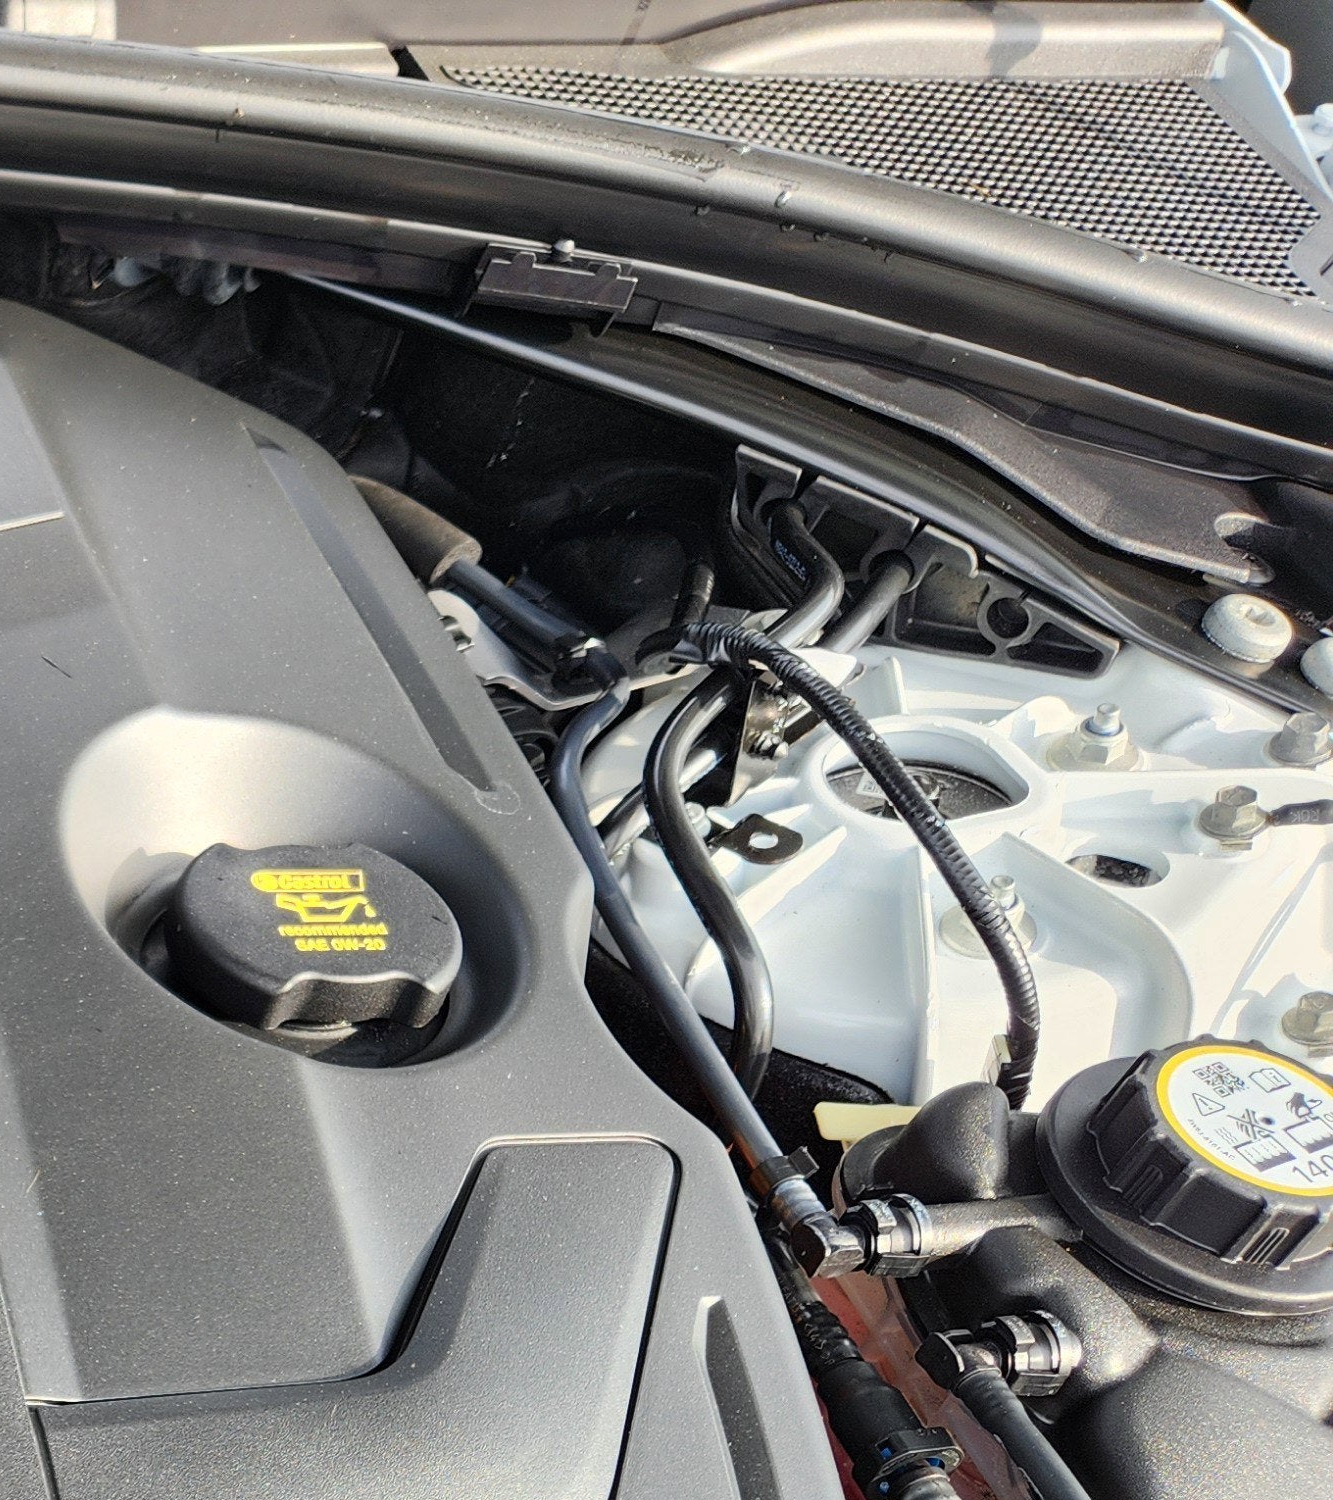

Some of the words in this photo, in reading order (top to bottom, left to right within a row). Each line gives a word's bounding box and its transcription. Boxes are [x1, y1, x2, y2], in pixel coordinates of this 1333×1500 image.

[277, 873, 351, 890] Castrol
[279, 923, 389, 936] recommended
[294, 938, 330, 952] SAE
[331, 938, 387, 952] 0W-20
